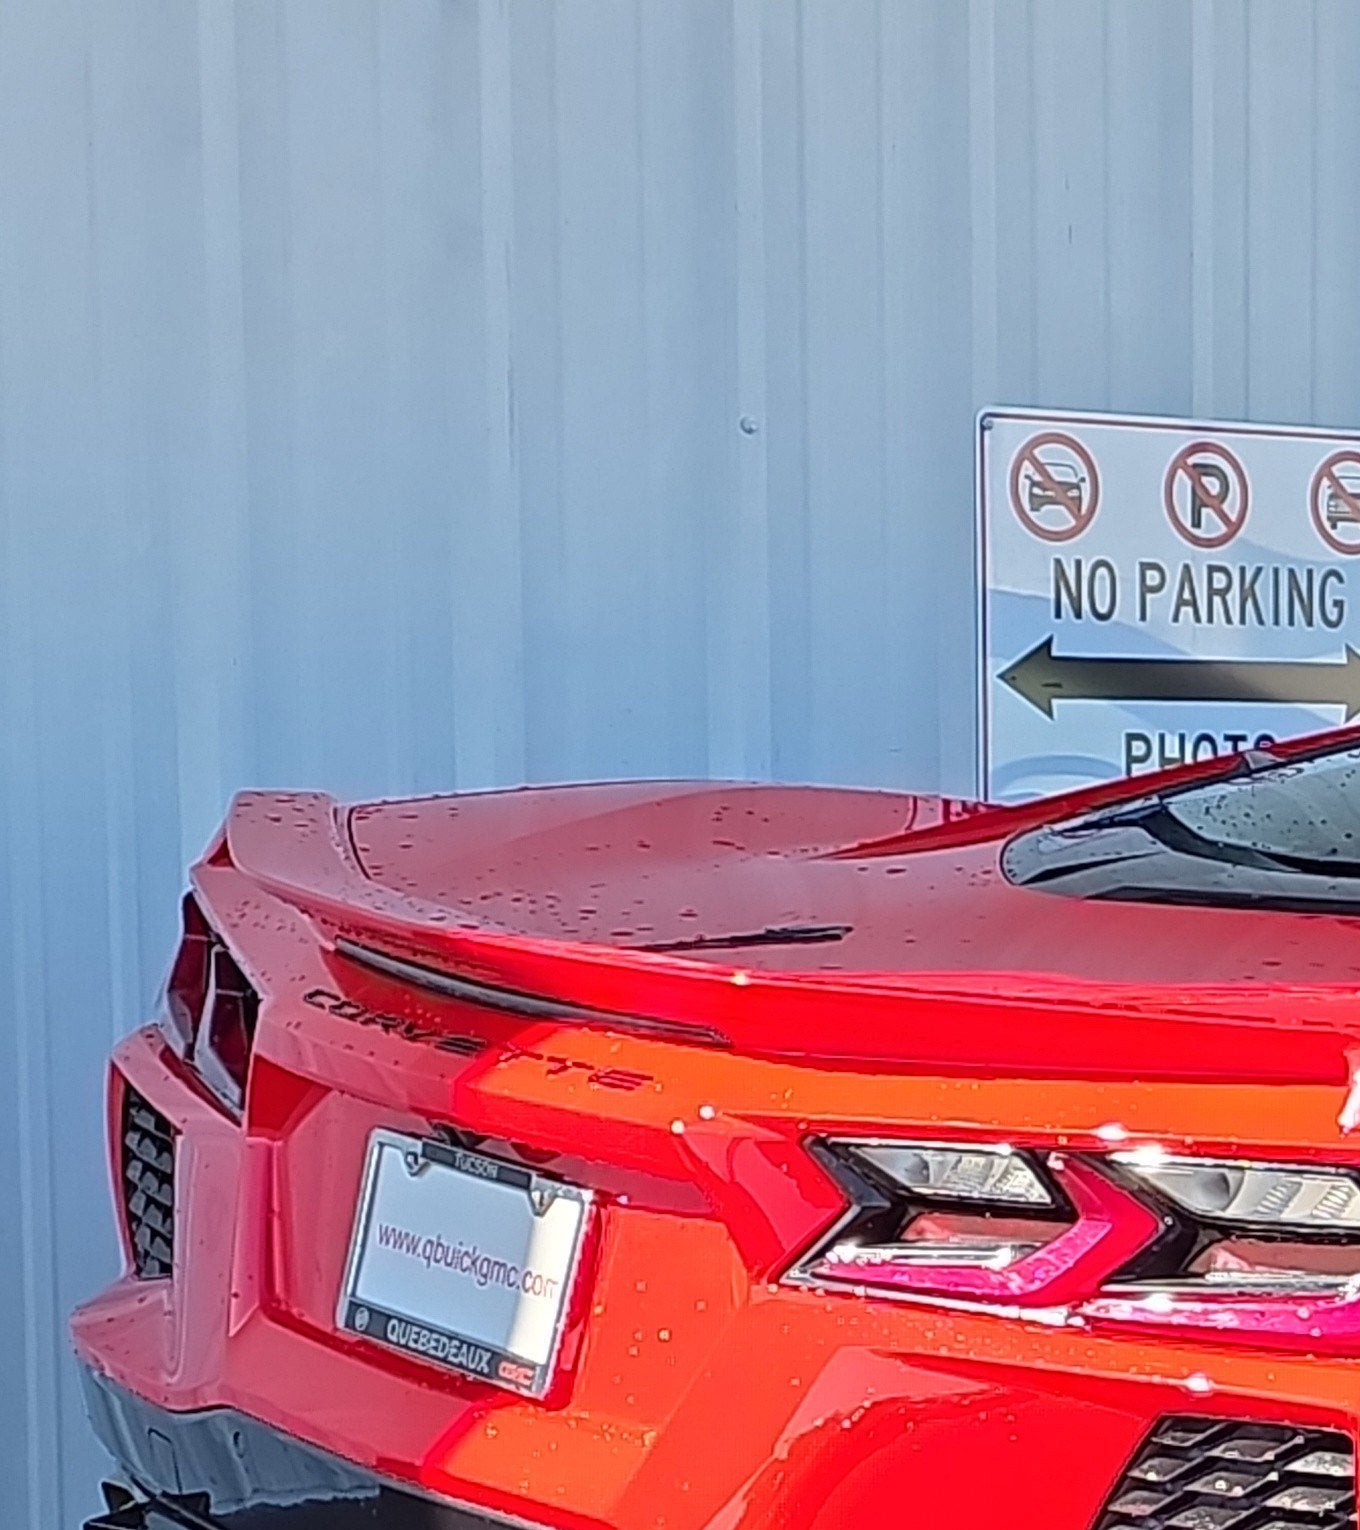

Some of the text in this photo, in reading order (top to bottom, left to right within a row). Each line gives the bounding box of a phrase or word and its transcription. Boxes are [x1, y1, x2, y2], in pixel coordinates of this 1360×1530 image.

[1052, 557, 1346, 629] NO PARKING
[302, 988, 654, 1092] CORVETTE
[386, 1318, 493, 1374] QUEBEDEAUX
